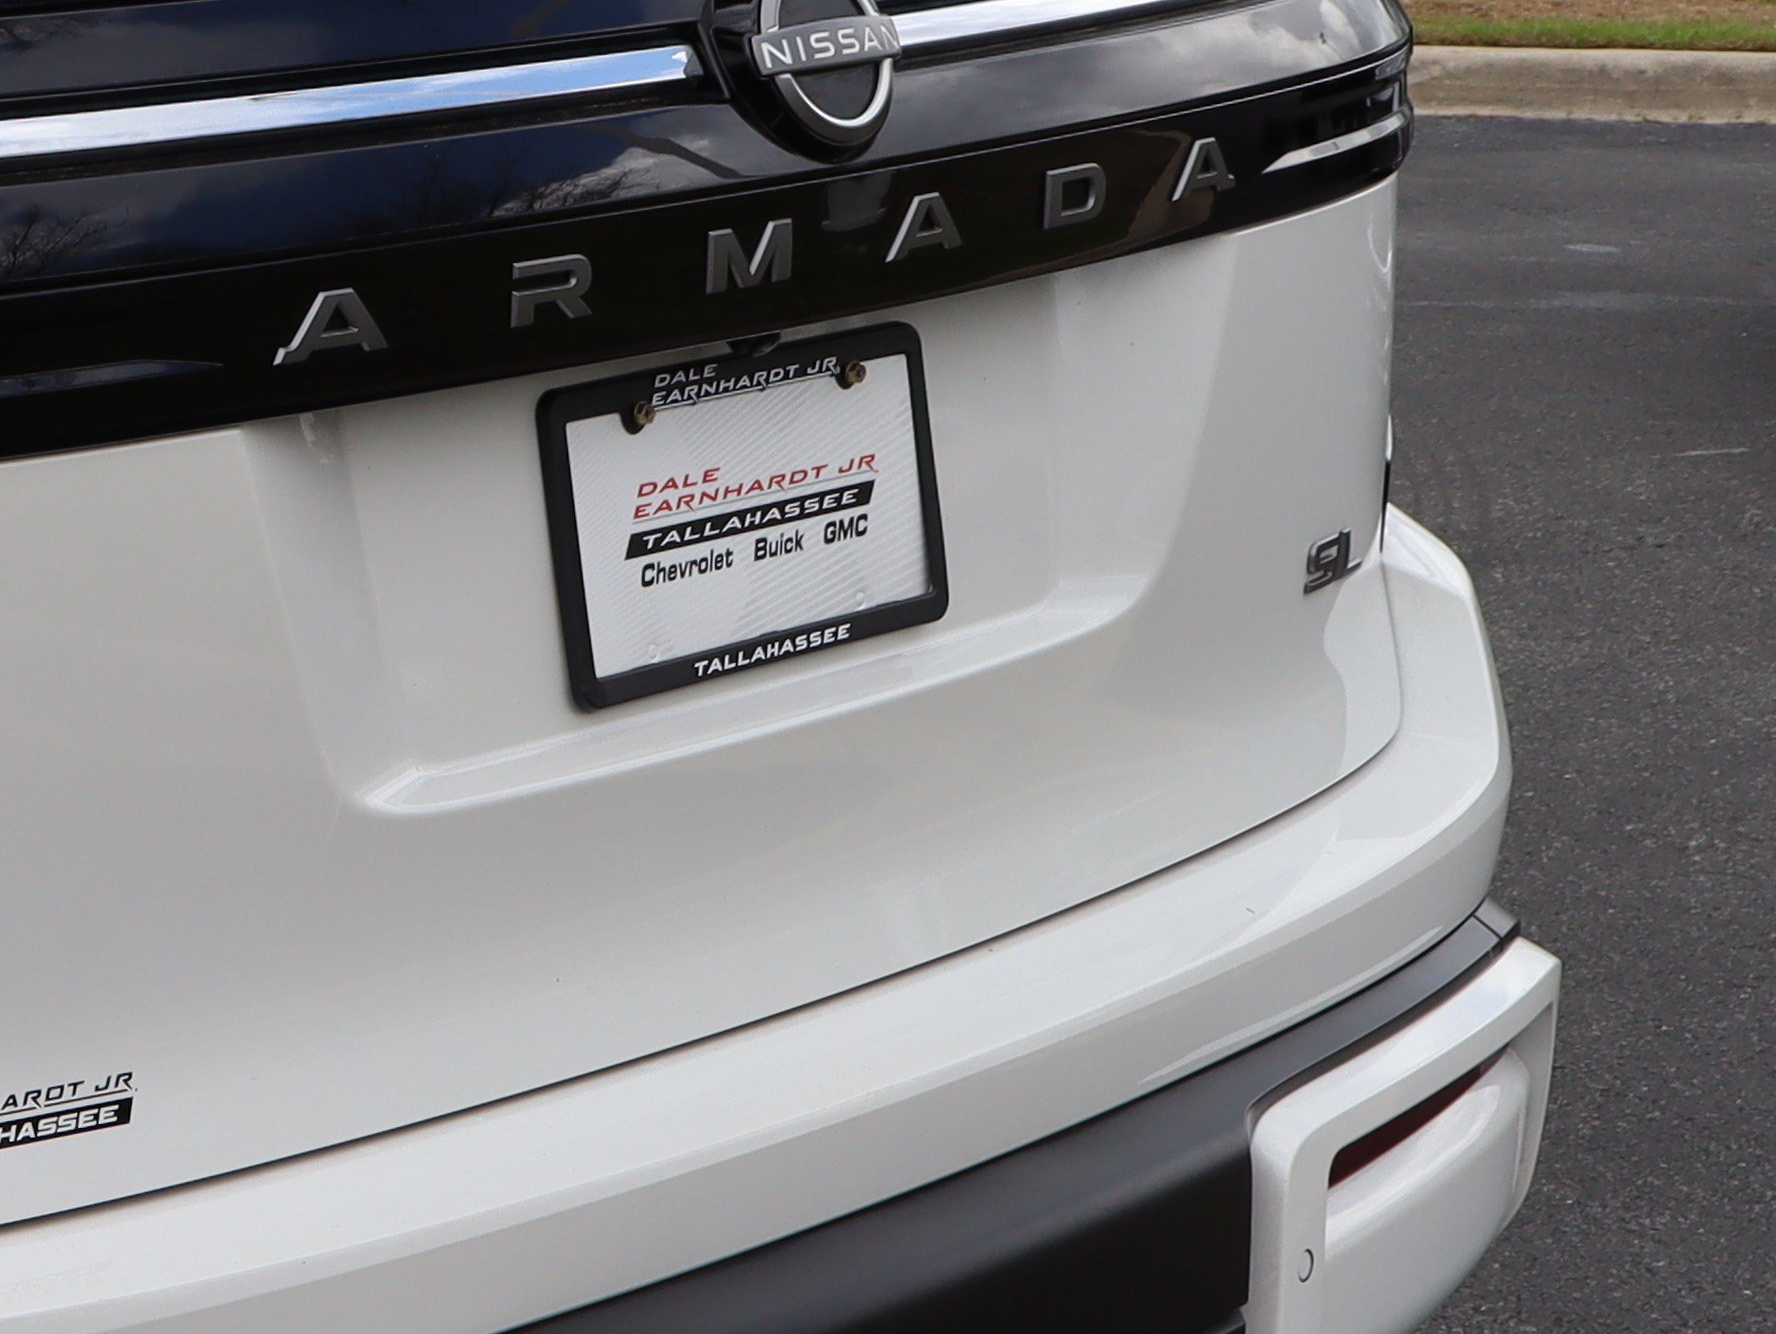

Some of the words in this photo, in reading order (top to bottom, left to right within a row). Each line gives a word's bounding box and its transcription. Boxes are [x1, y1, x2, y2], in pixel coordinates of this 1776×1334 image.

[760, 24, 900, 69] NISSAN
[271, 137, 1236, 367] ARMADA
[651, 364, 800, 407] EARNHARDT
[654, 363, 718, 389] DALE
[632, 464, 828, 520] EARNHARDT
[636, 467, 721, 499] DALE
[642, 488, 860, 551] TALLAHASSEE
[640, 547, 734, 588] Chevrolet
[753, 529, 804, 562] Buick
[823, 513, 869, 545] GMC
[694, 623, 851, 678] TALLAHASSEE
